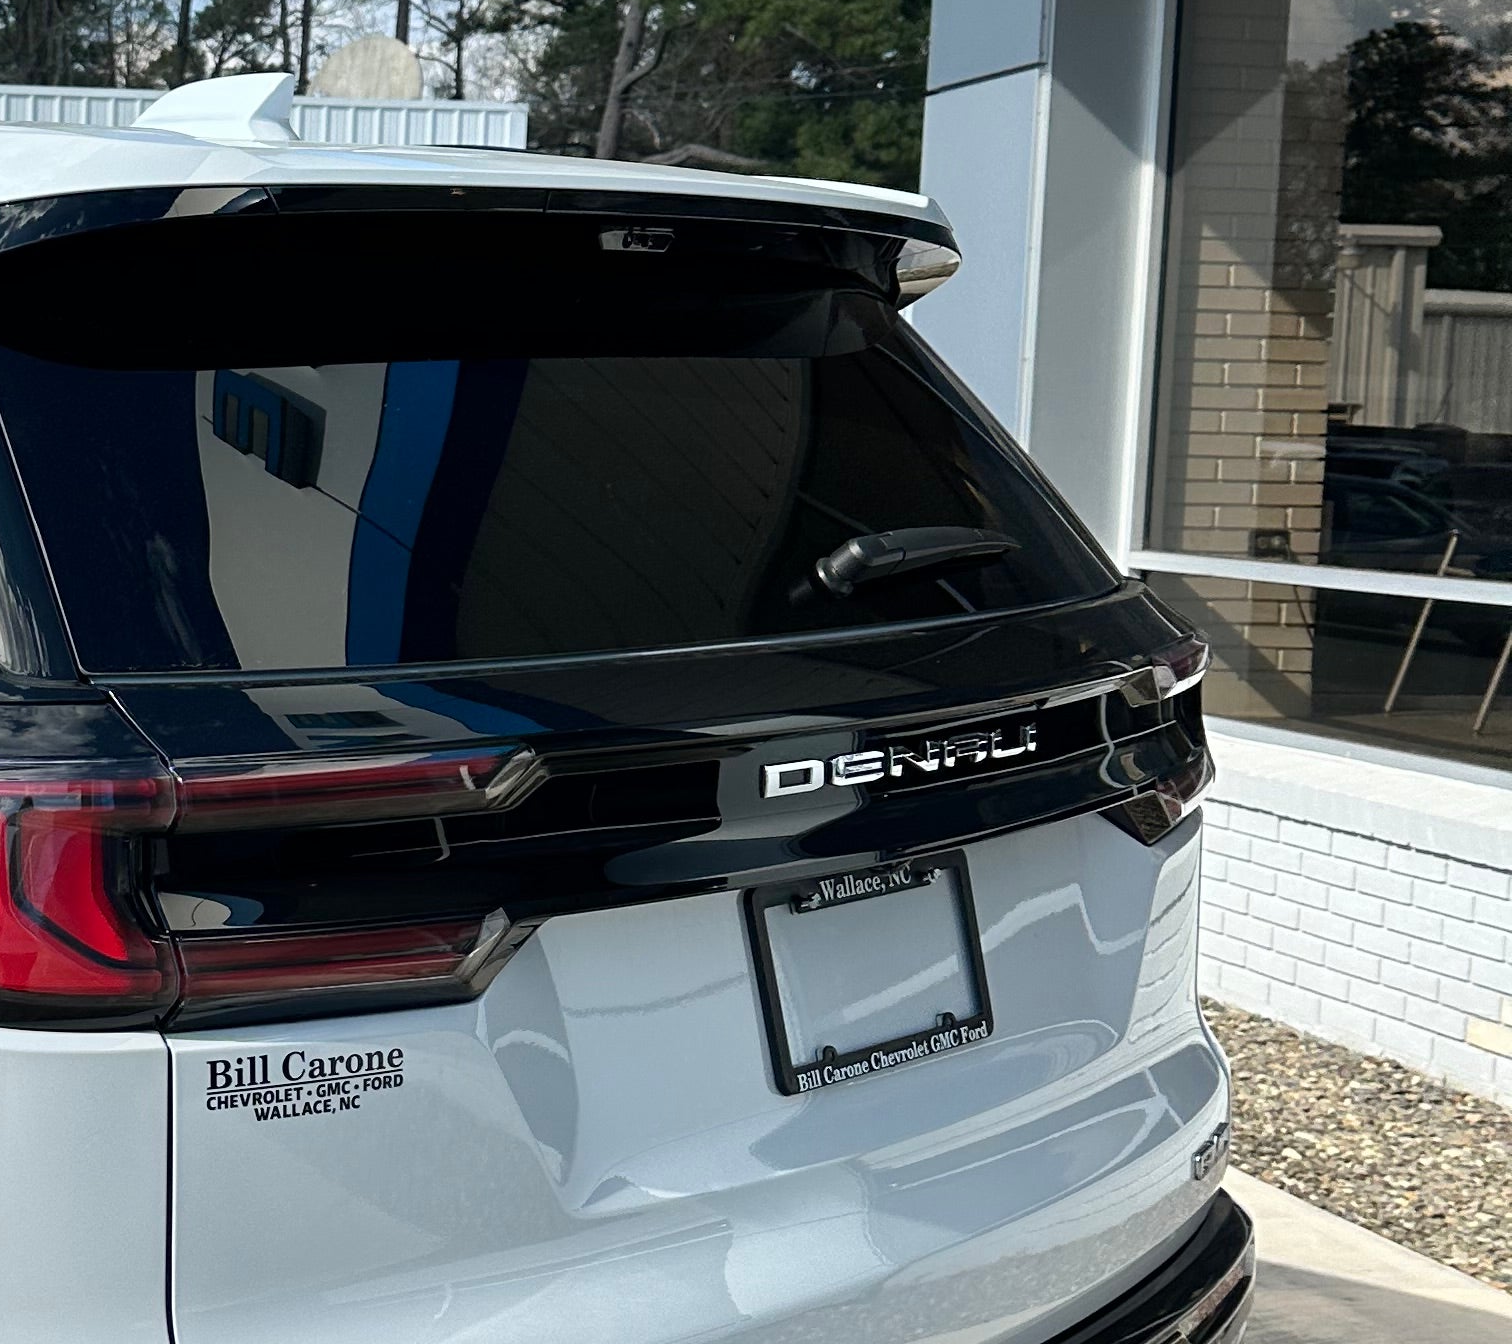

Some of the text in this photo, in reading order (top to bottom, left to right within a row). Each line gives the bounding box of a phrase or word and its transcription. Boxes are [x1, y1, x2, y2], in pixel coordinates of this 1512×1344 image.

[759, 722, 1037, 799] DENALI
[819, 874, 886, 902] Wallace,
[206, 1048, 404, 1091] Bill Carone
[797, 1021, 988, 1093] Bill Carone Chevrolet GMC Ford
[206, 1073, 404, 1111] CHEVROLET GMC FORD
[254, 1094, 361, 1122] WALLACE, NC
